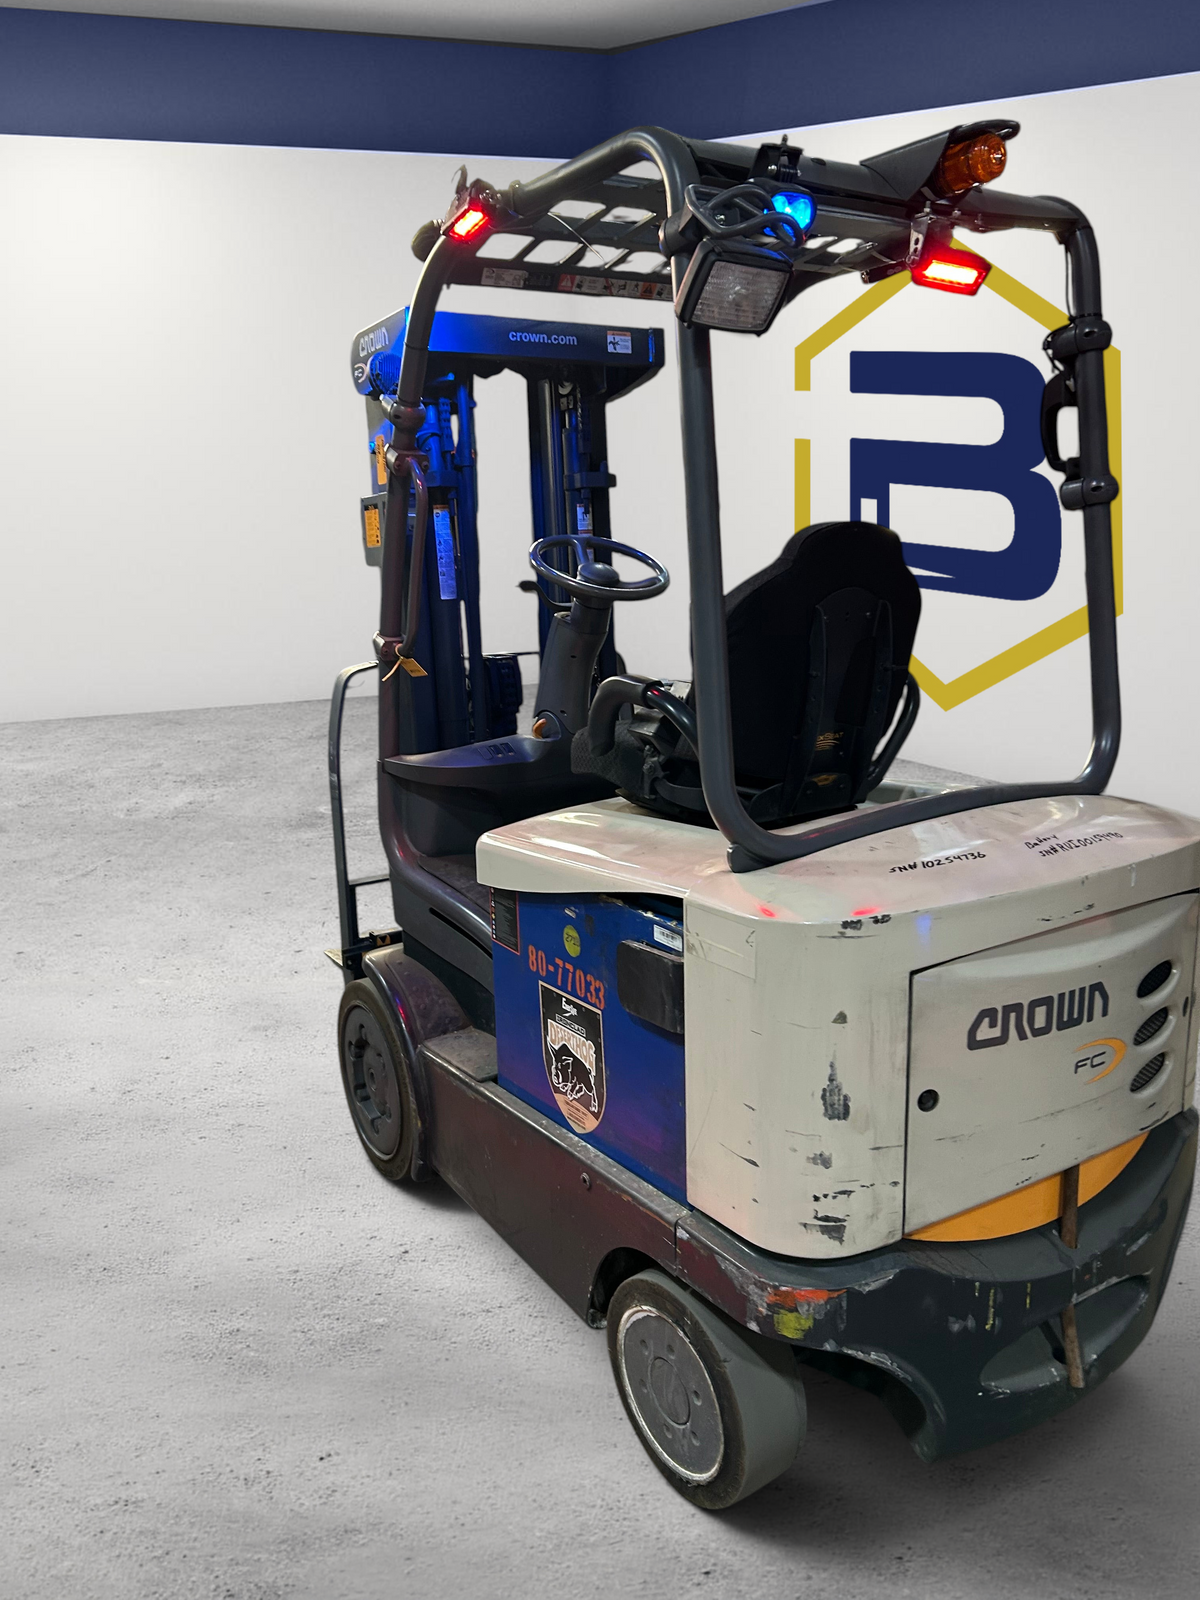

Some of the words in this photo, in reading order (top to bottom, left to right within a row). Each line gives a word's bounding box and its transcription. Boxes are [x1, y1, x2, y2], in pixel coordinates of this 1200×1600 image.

[359, 327, 389, 357] CROWN
[508, 331, 578, 346] crown.com
[528, 944, 605, 1010] 80-77033
[967, 981, 1110, 1051] CROWN
[1074, 1051, 1107, 1074] FC
